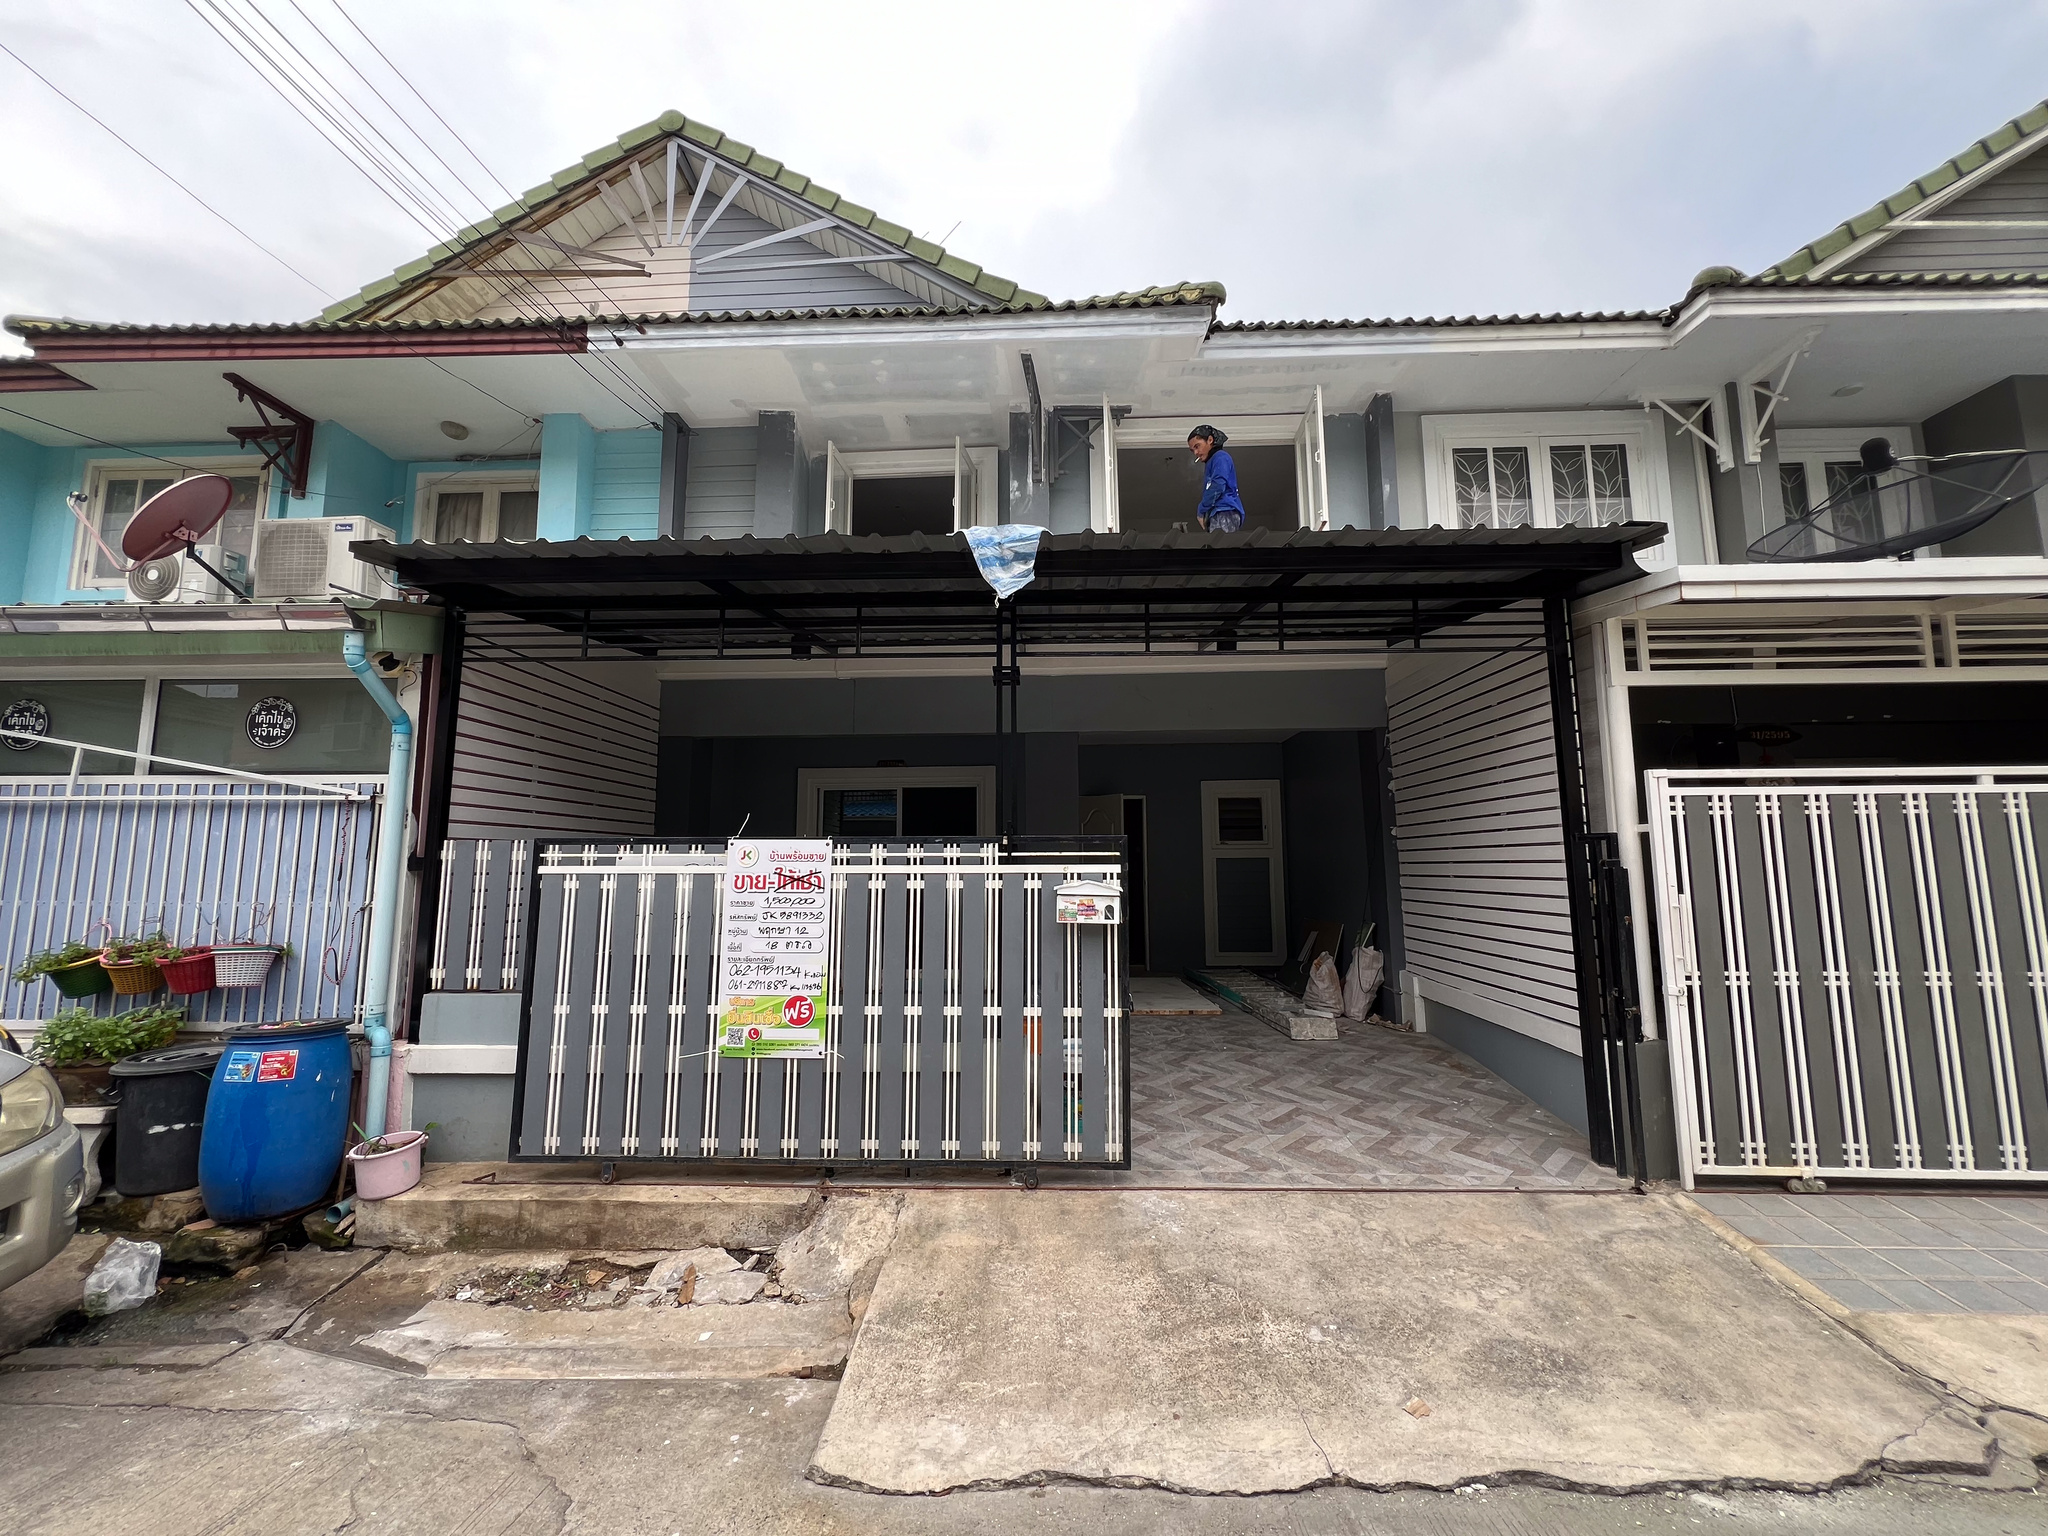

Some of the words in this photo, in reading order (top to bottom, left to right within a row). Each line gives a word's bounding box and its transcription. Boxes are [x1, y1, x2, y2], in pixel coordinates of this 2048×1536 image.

[7, 711, 37, 726] เค้กไข่
[255, 709, 284, 724] เค้กไข่
[740, 849, 753, 861] JK
[769, 850, 827, 861] บ้านพร้อมขาย
[762, 911, 778, 921] JK
[794, 926, 809, 935] 12
[765, 941, 779, 950] 18
[728, 963, 802, 978] 062-1951134
[784, 999, 812, 1021] ฟรี
